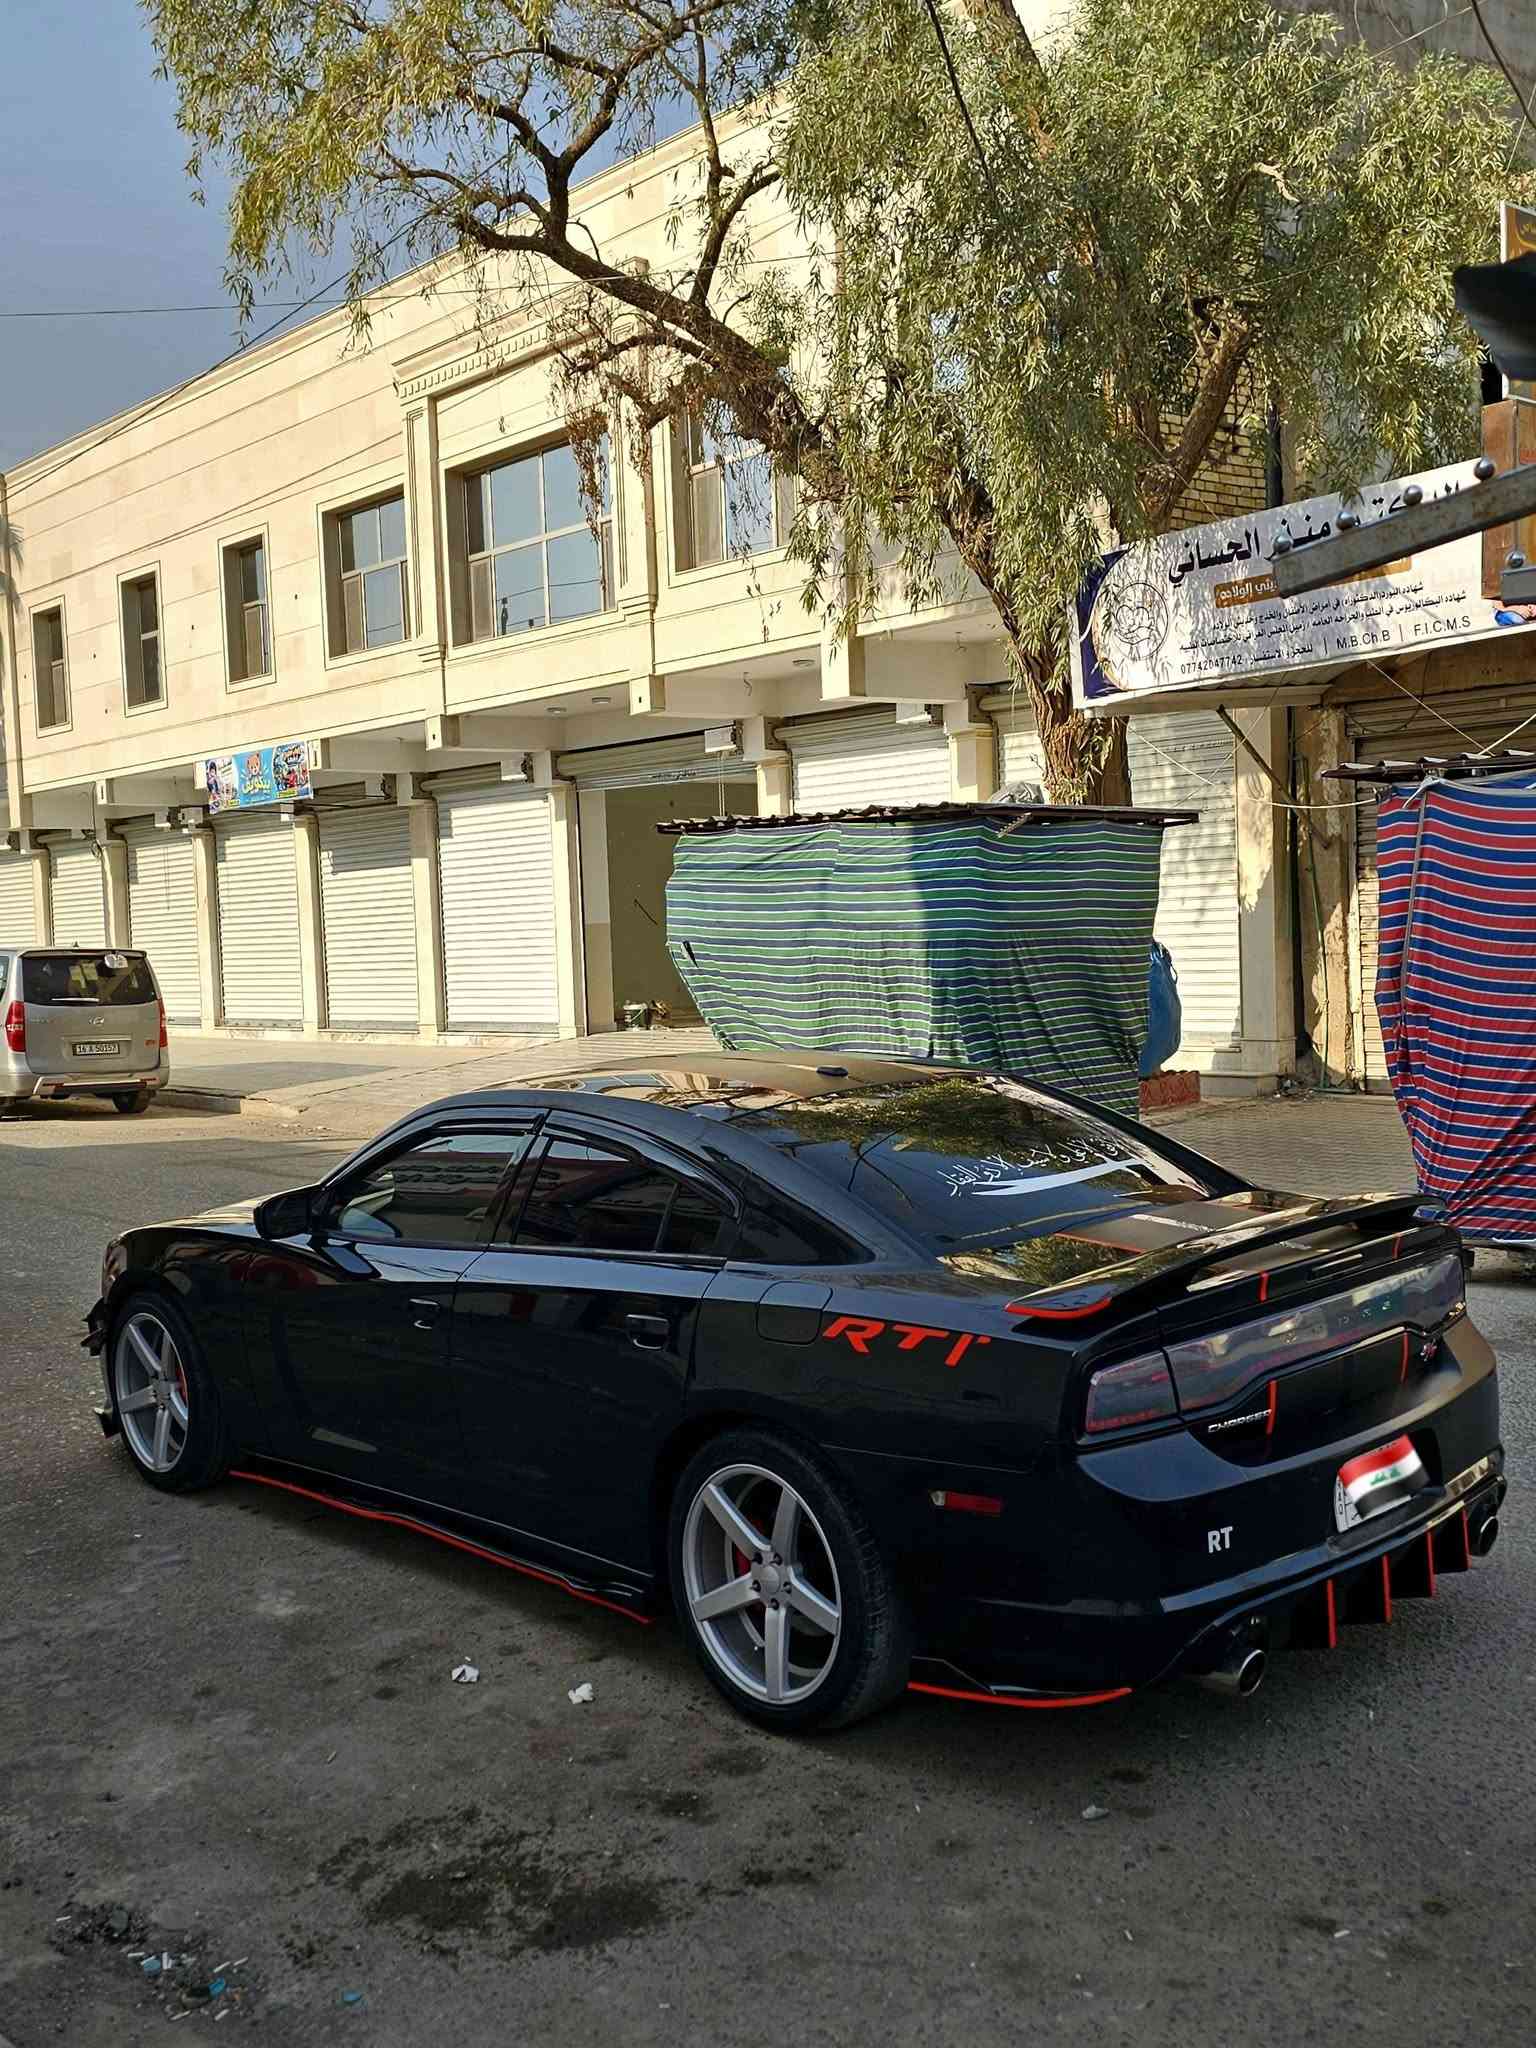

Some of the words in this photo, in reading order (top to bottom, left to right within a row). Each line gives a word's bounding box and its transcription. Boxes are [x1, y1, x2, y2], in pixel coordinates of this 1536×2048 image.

[1169, 527, 1261, 588] الحساني
[1336, 630, 1390, 649] M.B.Ch.B
[1414, 616, 1470, 636] F.I.C.M.S
[1207, 1526, 1233, 1554] RT
